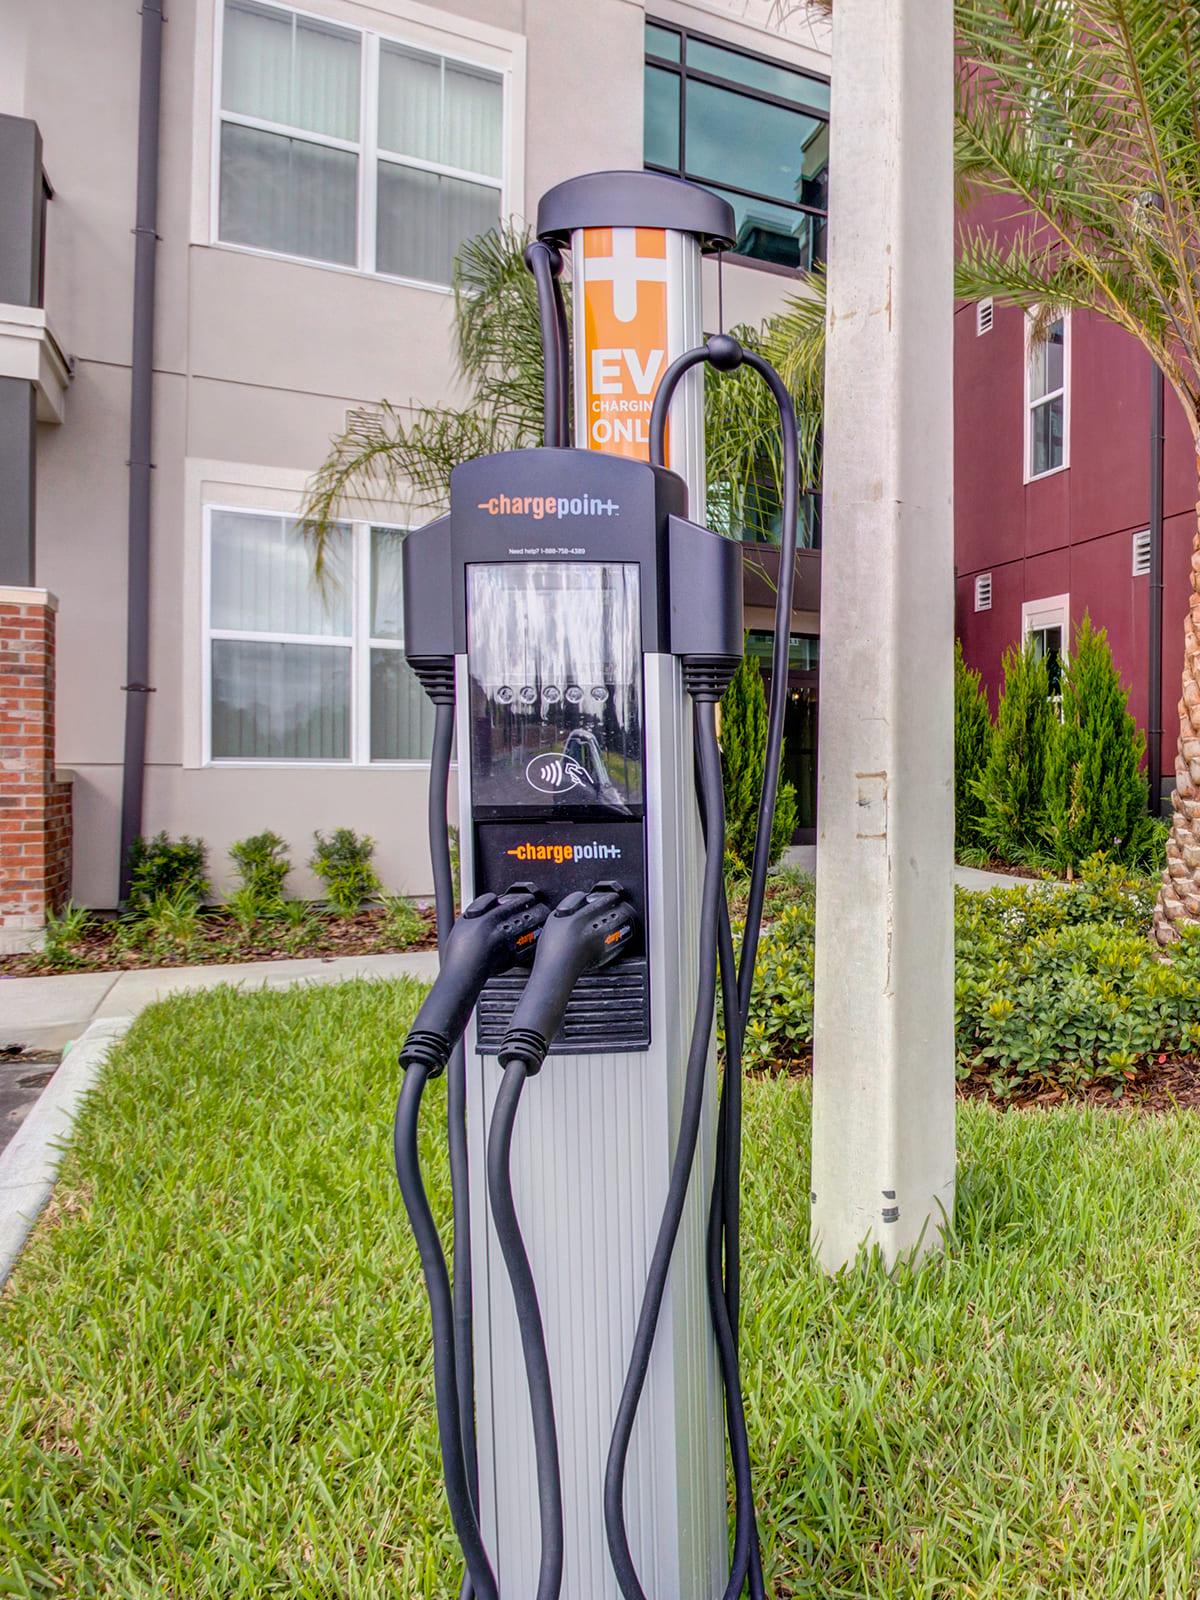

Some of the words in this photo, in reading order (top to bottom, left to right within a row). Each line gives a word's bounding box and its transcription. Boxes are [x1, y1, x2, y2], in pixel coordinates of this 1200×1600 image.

[591, 348, 664, 395] EV
[592, 400, 653, 412] CHARGIN
[592, 418, 650, 443] ONL
